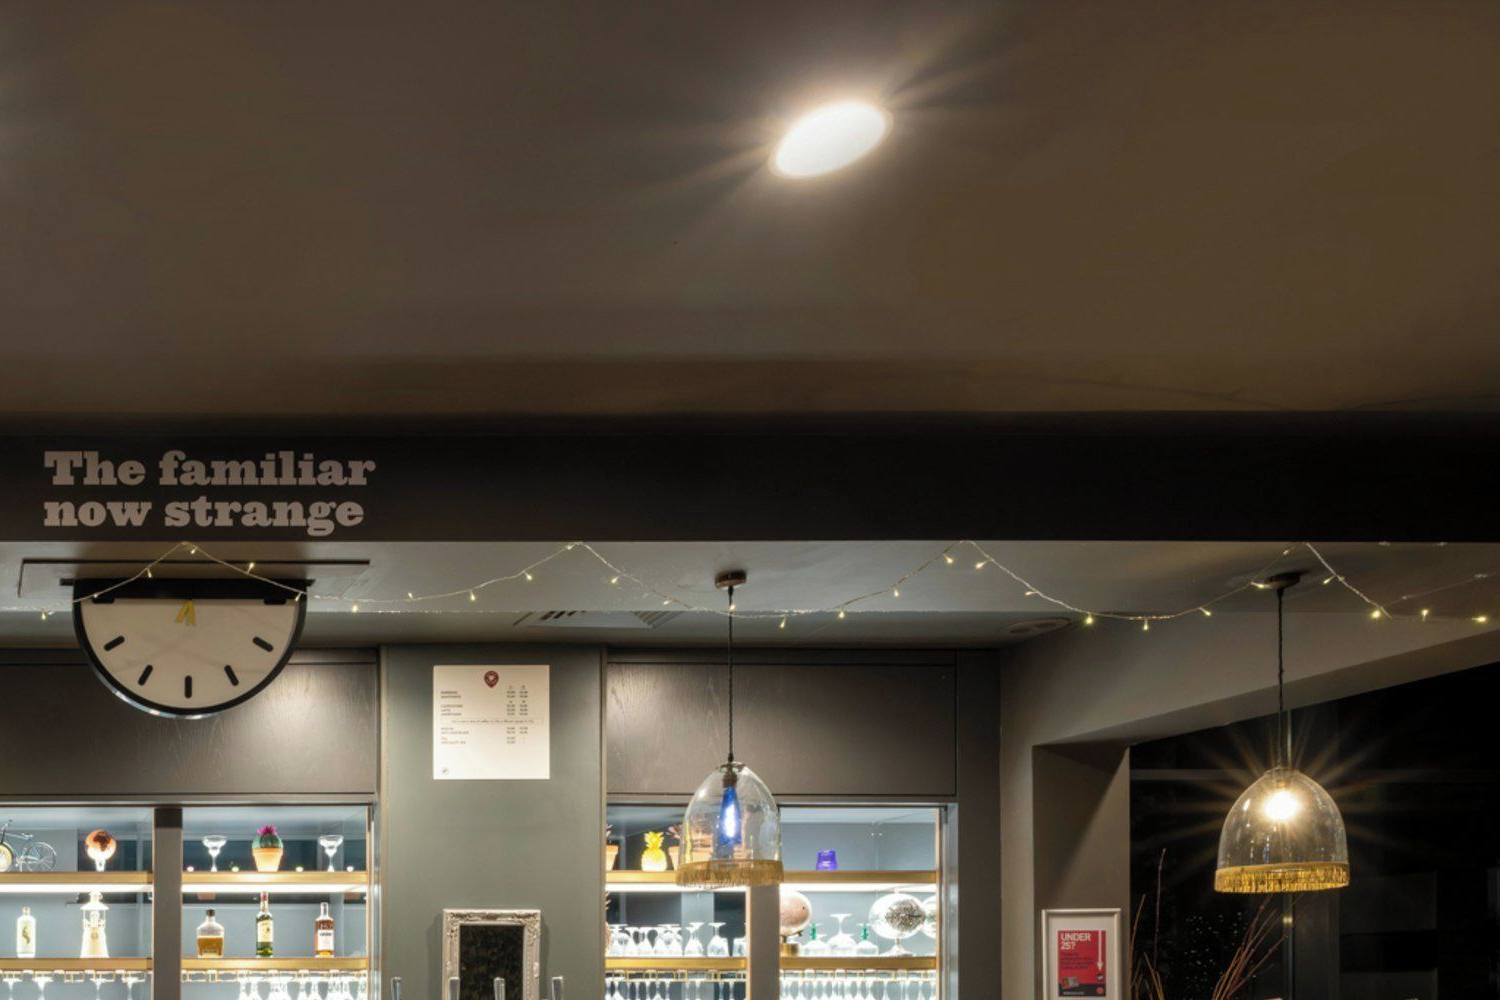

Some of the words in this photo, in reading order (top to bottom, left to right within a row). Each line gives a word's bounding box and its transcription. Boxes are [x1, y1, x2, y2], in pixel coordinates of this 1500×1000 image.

[44, 451, 146, 486] The
[159, 450, 375, 486] familiar
[43, 500, 153, 527] now
[164, 495, 365, 537] strange
[1060, 933, 1092, 942] UNDER
[1060, 941, 1076, 950] 25?
